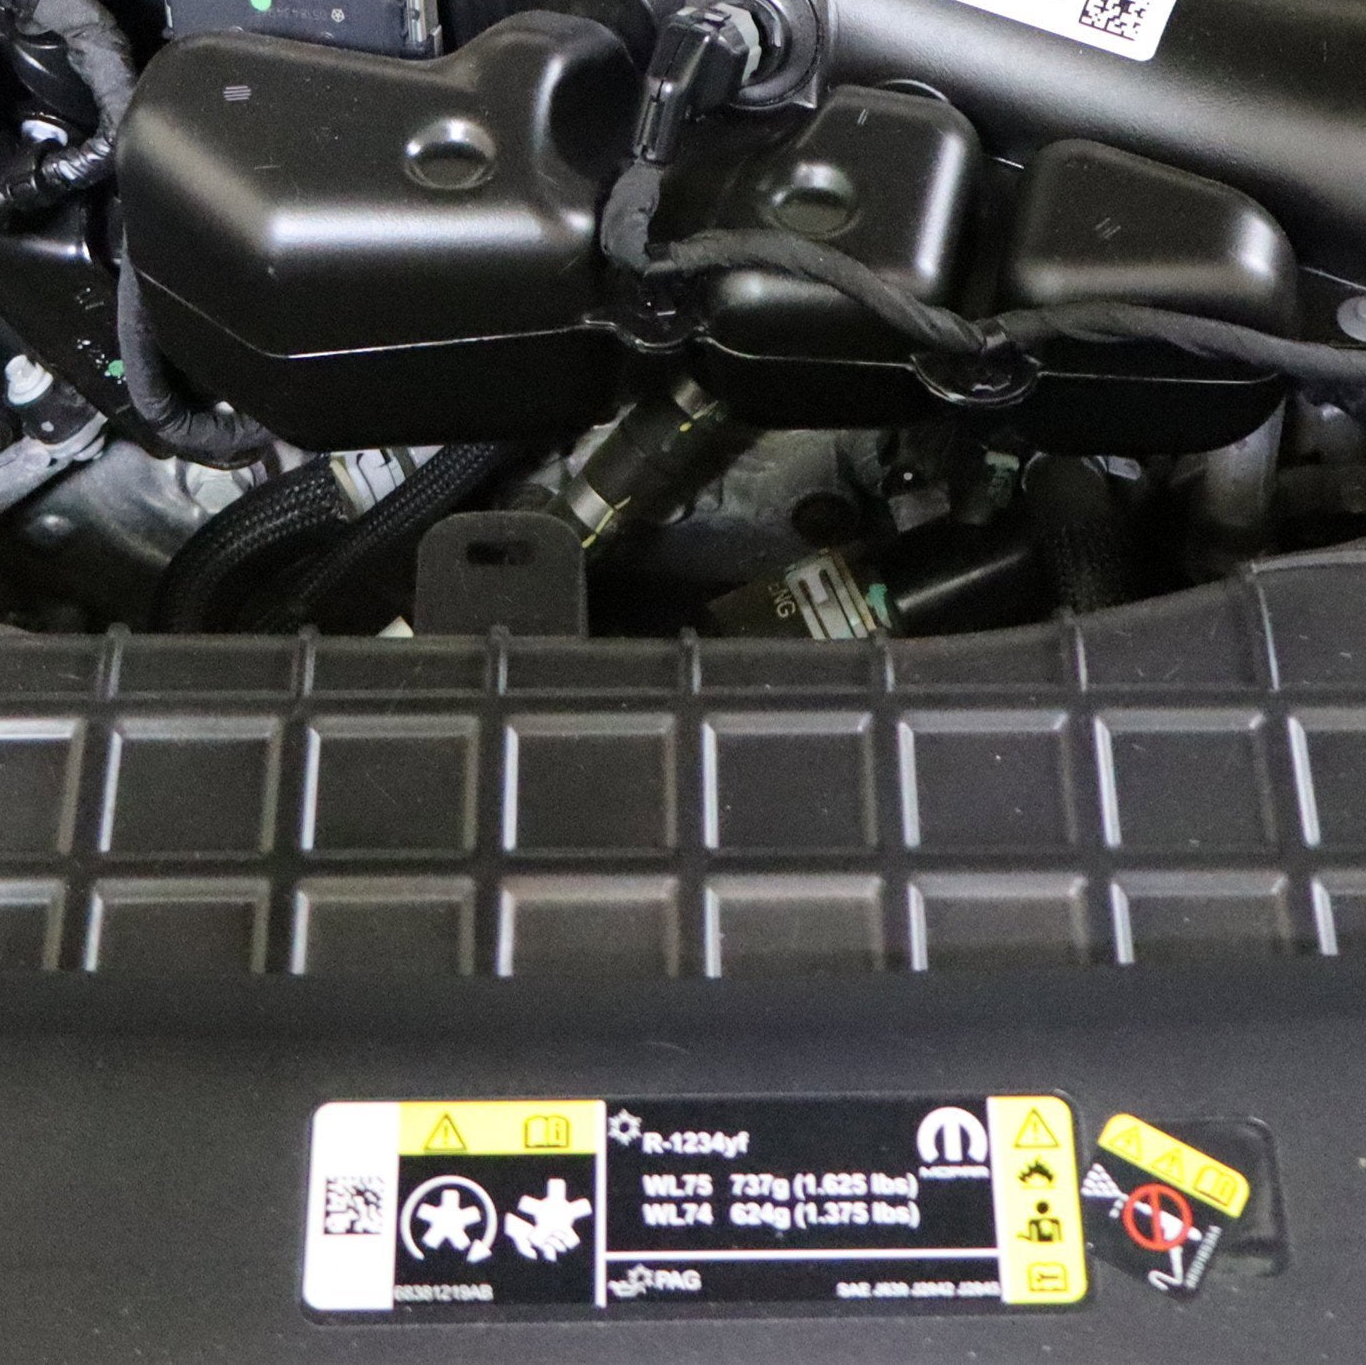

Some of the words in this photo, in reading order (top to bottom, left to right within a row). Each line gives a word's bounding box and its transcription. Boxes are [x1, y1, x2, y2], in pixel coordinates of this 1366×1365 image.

[642, 1130, 750, 1158] R-1234yf
[642, 1174, 714, 1197] WL75
[730, 1173, 791, 1200] 737g
[793, 1173, 868, 1200] (1.625
[870, 1173, 920, 1200] lbs)
[642, 1202, 714, 1226] WL74
[730, 1201, 791, 1229] 624g
[793, 1201, 868, 1229] (1.375
[870, 1201, 920, 1229] lbs)
[654, 1269, 703, 1292] PAG
